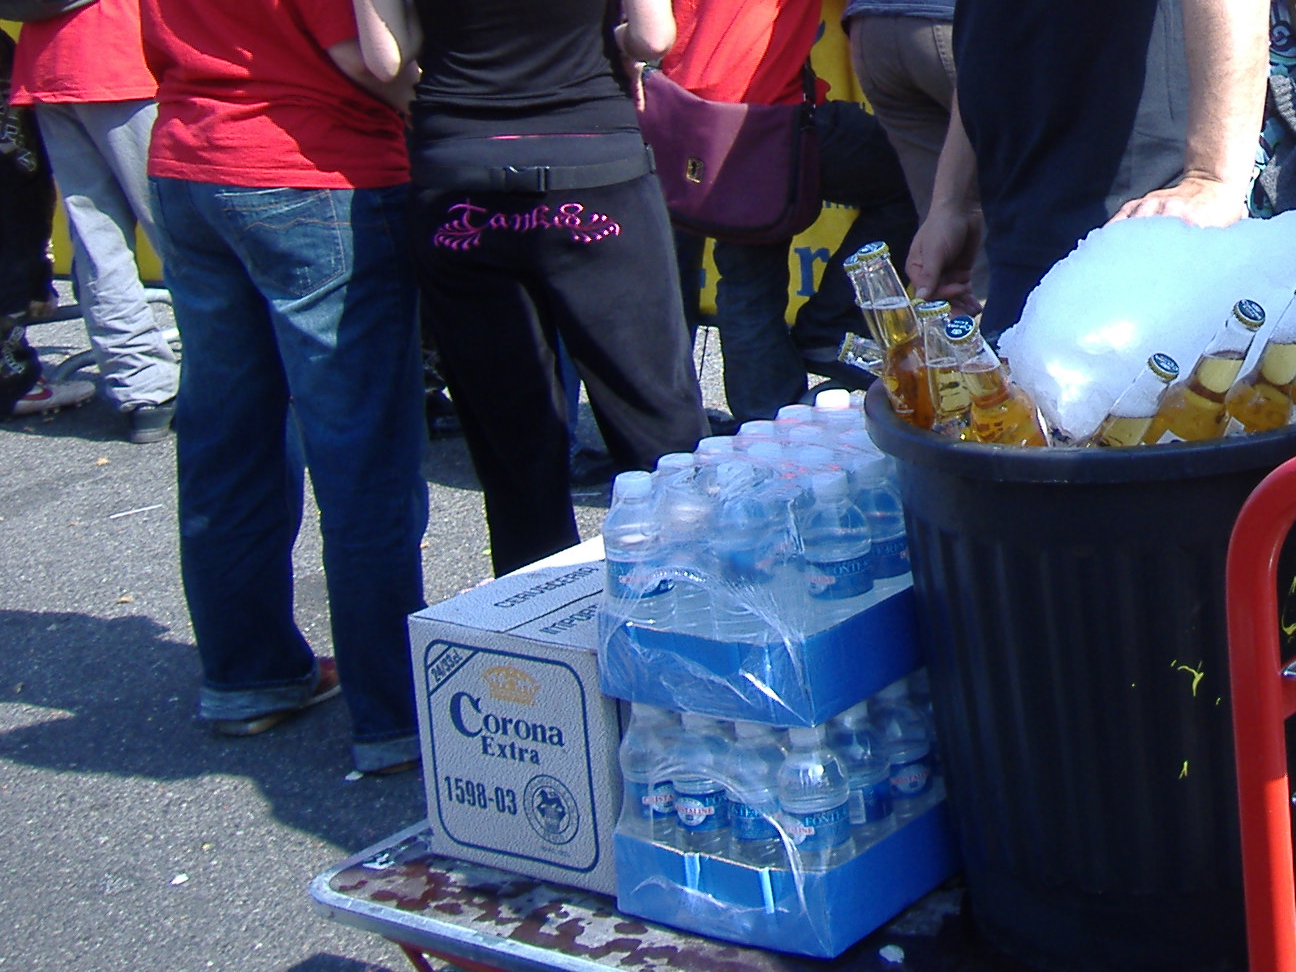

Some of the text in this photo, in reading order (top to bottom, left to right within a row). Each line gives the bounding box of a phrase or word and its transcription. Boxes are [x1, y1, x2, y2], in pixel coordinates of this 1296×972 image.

[450, 691, 565, 748] Corona
[481, 734, 541, 766] Extra
[444, 775, 518, 816] 1598-03
